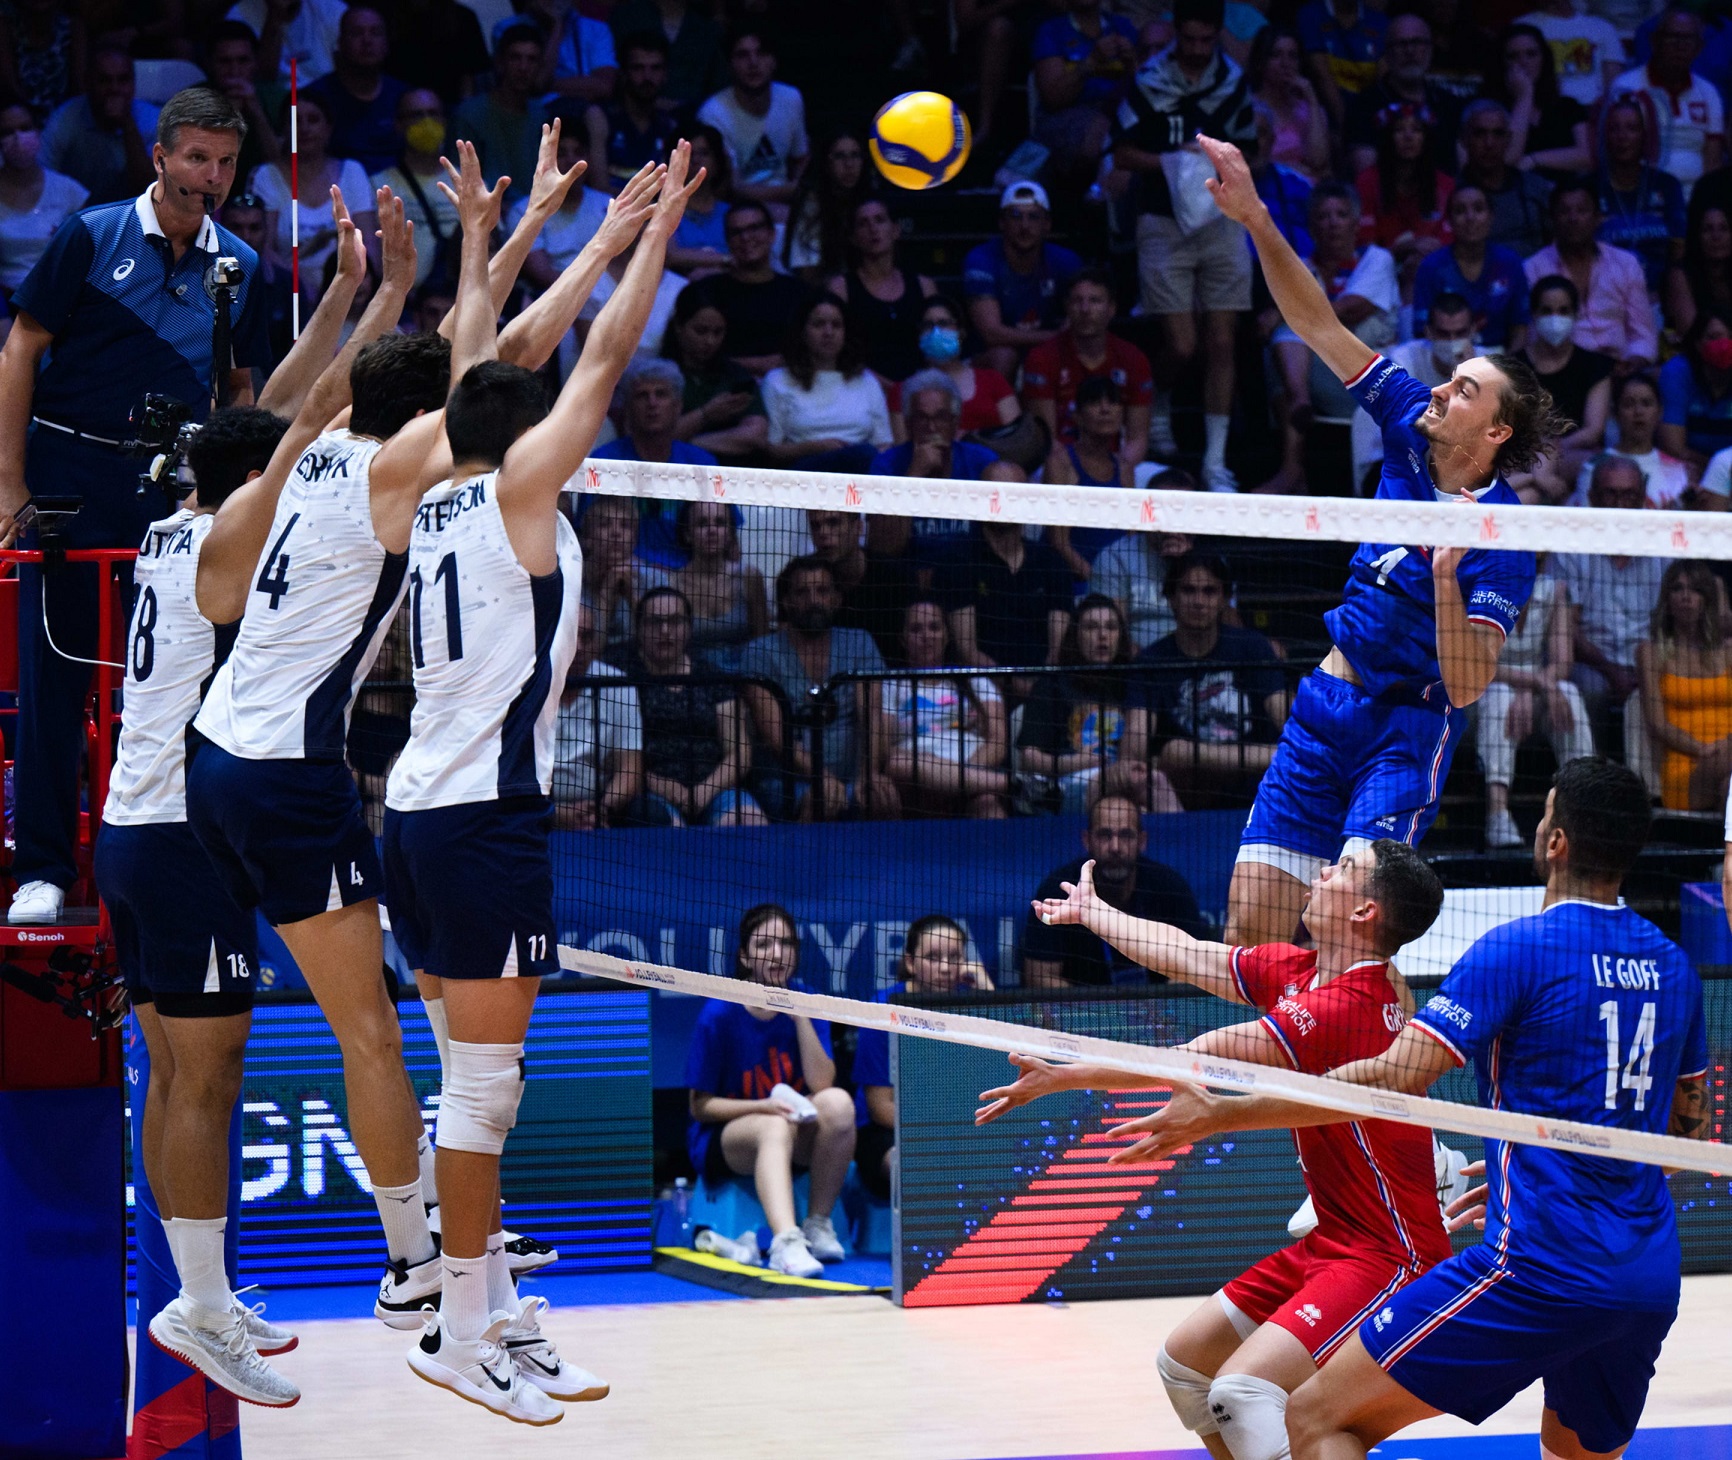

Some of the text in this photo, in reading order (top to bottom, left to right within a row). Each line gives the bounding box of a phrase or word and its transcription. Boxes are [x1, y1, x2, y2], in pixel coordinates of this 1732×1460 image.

[256, 512, 301, 611] 4
[410, 551, 464, 670] 11
[350, 861, 364, 886] 4
[28, 933, 65, 942] Senoh
[528, 934, 547, 962] 11
[227, 953, 250, 978] 18
[1592, 954, 1660, 991] LE GOFF
[1599, 1000, 1656, 1112] 14
[1294, 1308, 1316, 1328] errea
